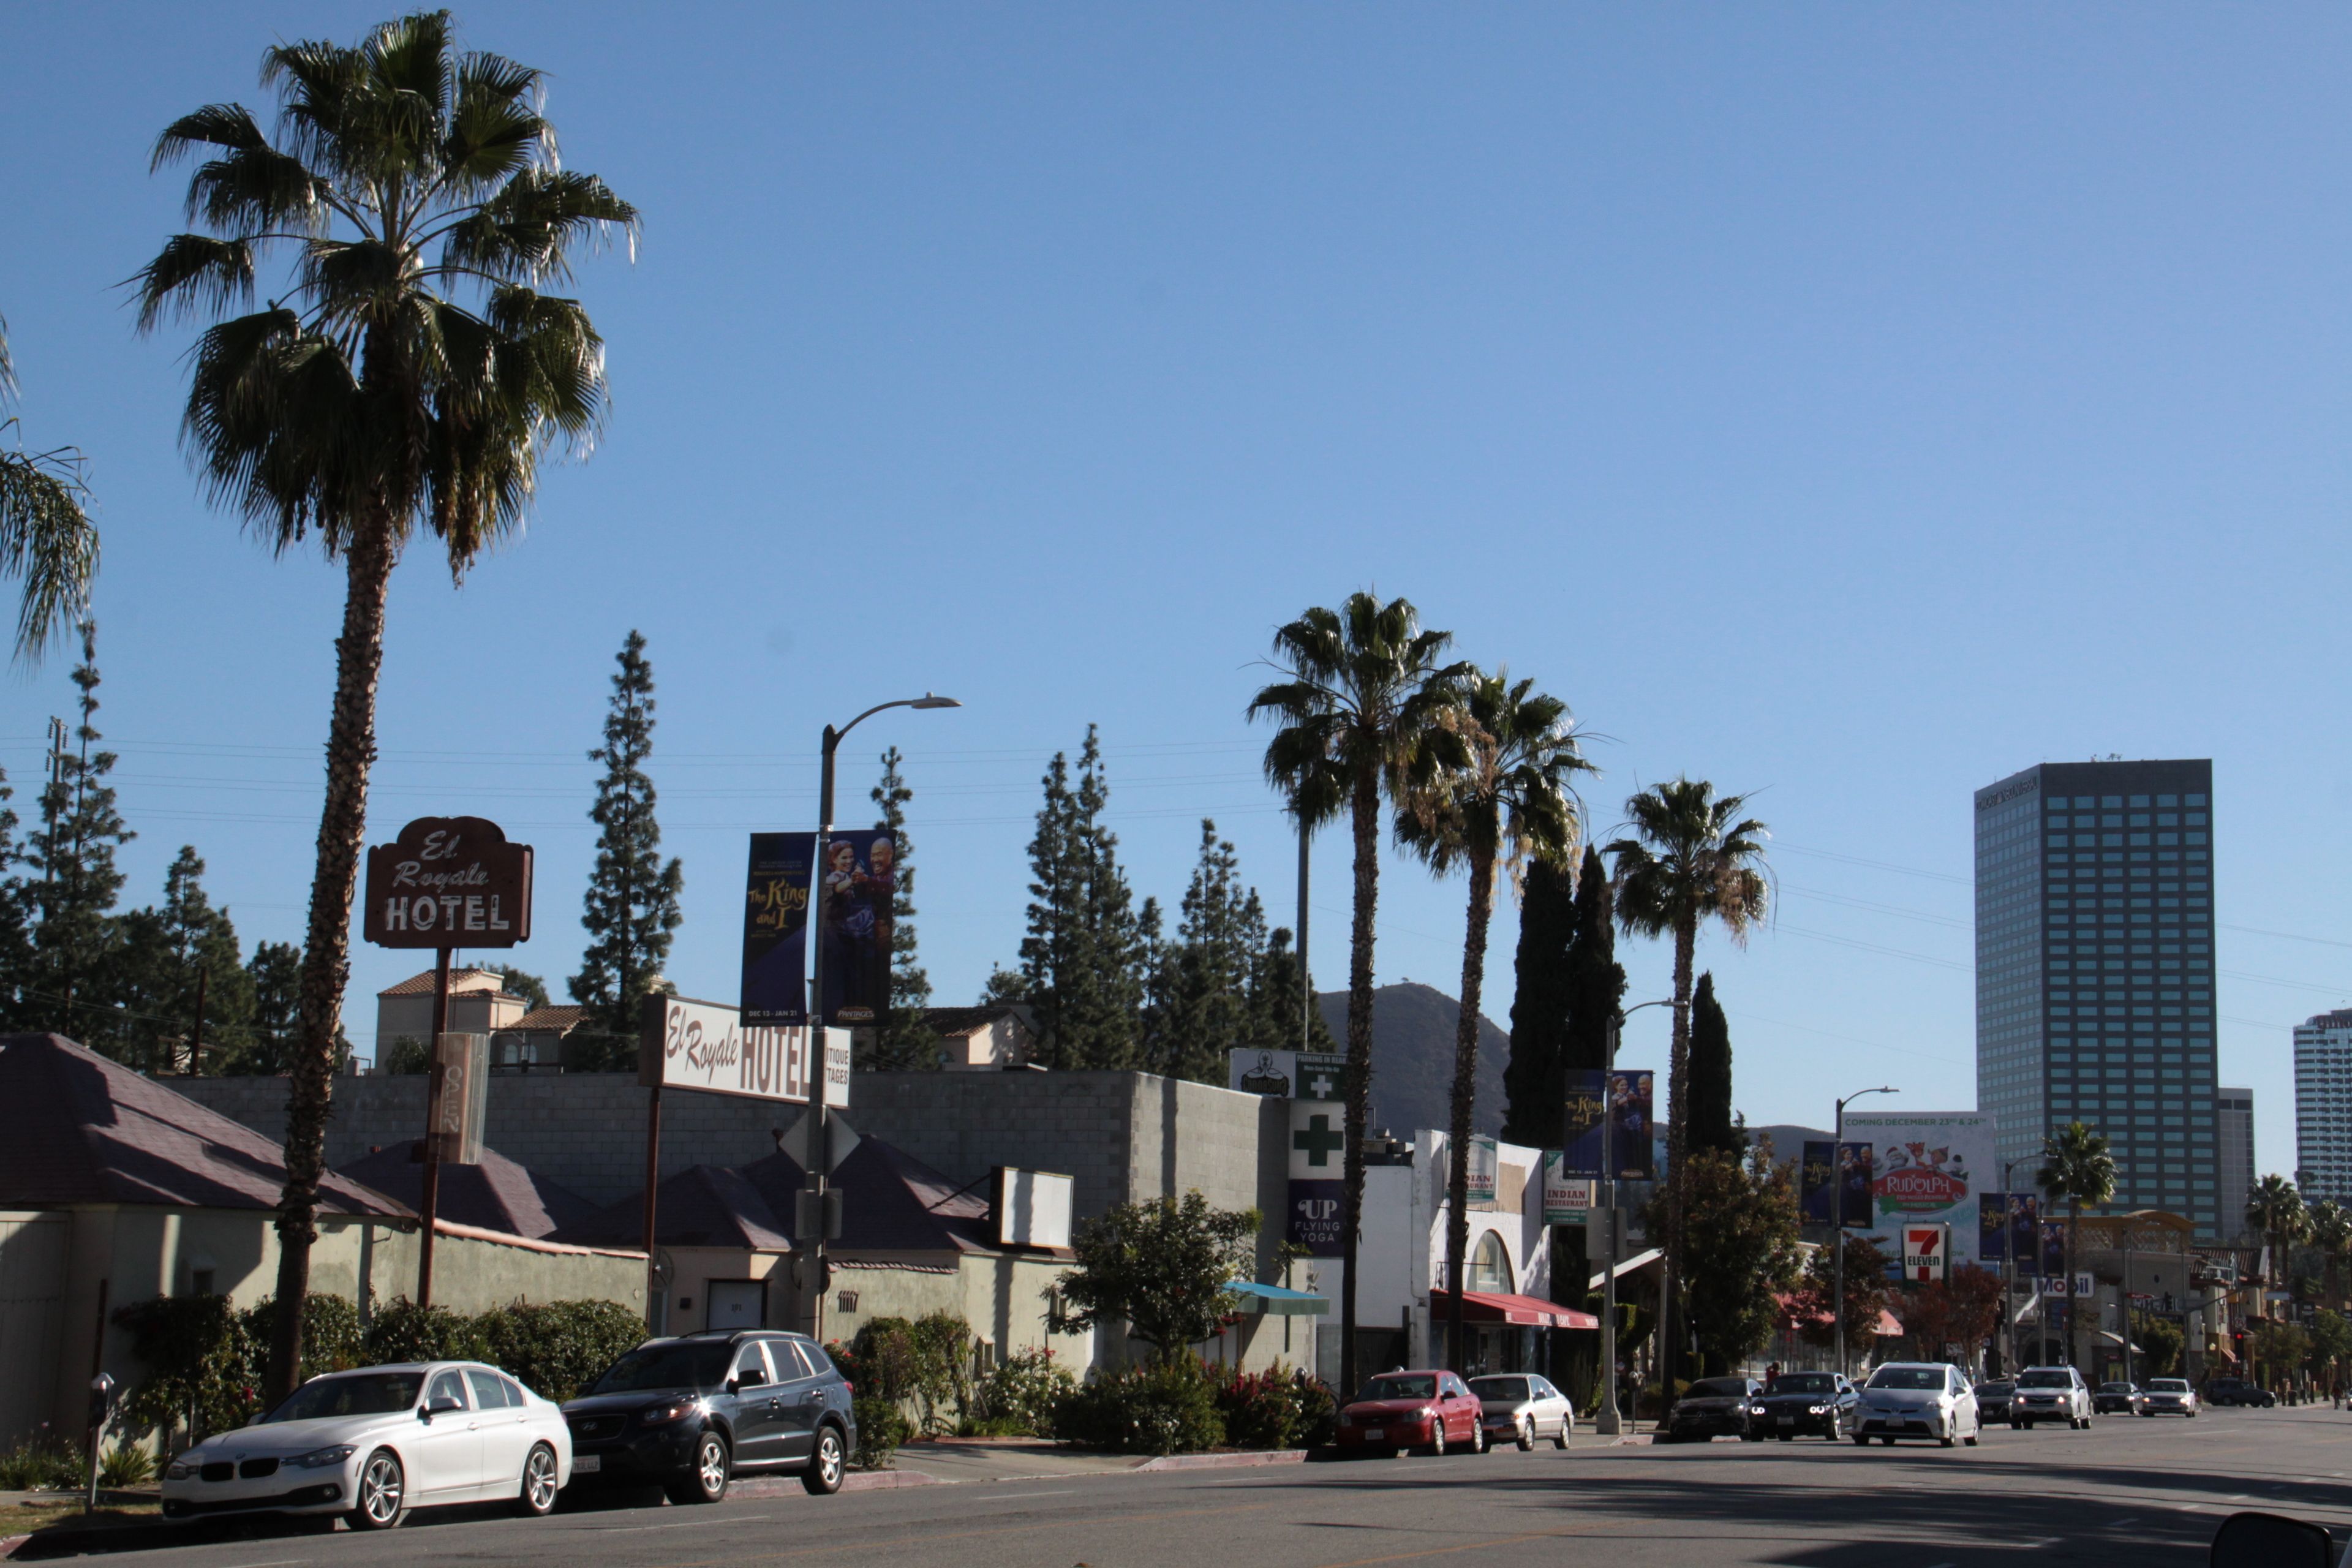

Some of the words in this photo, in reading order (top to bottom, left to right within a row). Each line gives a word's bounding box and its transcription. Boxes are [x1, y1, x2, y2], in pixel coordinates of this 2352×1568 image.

[420, 830, 460, 860] El
[392, 861, 489, 893] Royale
[748, 888, 766, 903] The
[764, 877, 809, 911] King
[386, 894, 509, 931] HOTEL
[756, 911, 777, 925] and
[774, 905, 791, 930] I
[666, 1006, 687, 1058] El
[685, 1020, 739, 1085] Royale
[740, 1026, 810, 1097] HOTEL
[826, 1047, 848, 1065] TIQUE
[1297, 1055, 1323, 1063] PARKING
[826, 1067, 848, 1085] TAGES
[444, 1065, 463, 1133] OPEN
[1577, 1096, 1604, 1115] King
[1583, 1112, 1593, 1125] I
[1547, 1189, 1586, 1199] INDIAN
[1887, 1176, 1951, 1194] RUDOLPH
[1298, 1199, 1338, 1219] UP
[1295, 1221, 1340, 1231] FLYING
[1300, 1232, 1335, 1242] YOGA
[1909, 1229, 1939, 1281] 7
